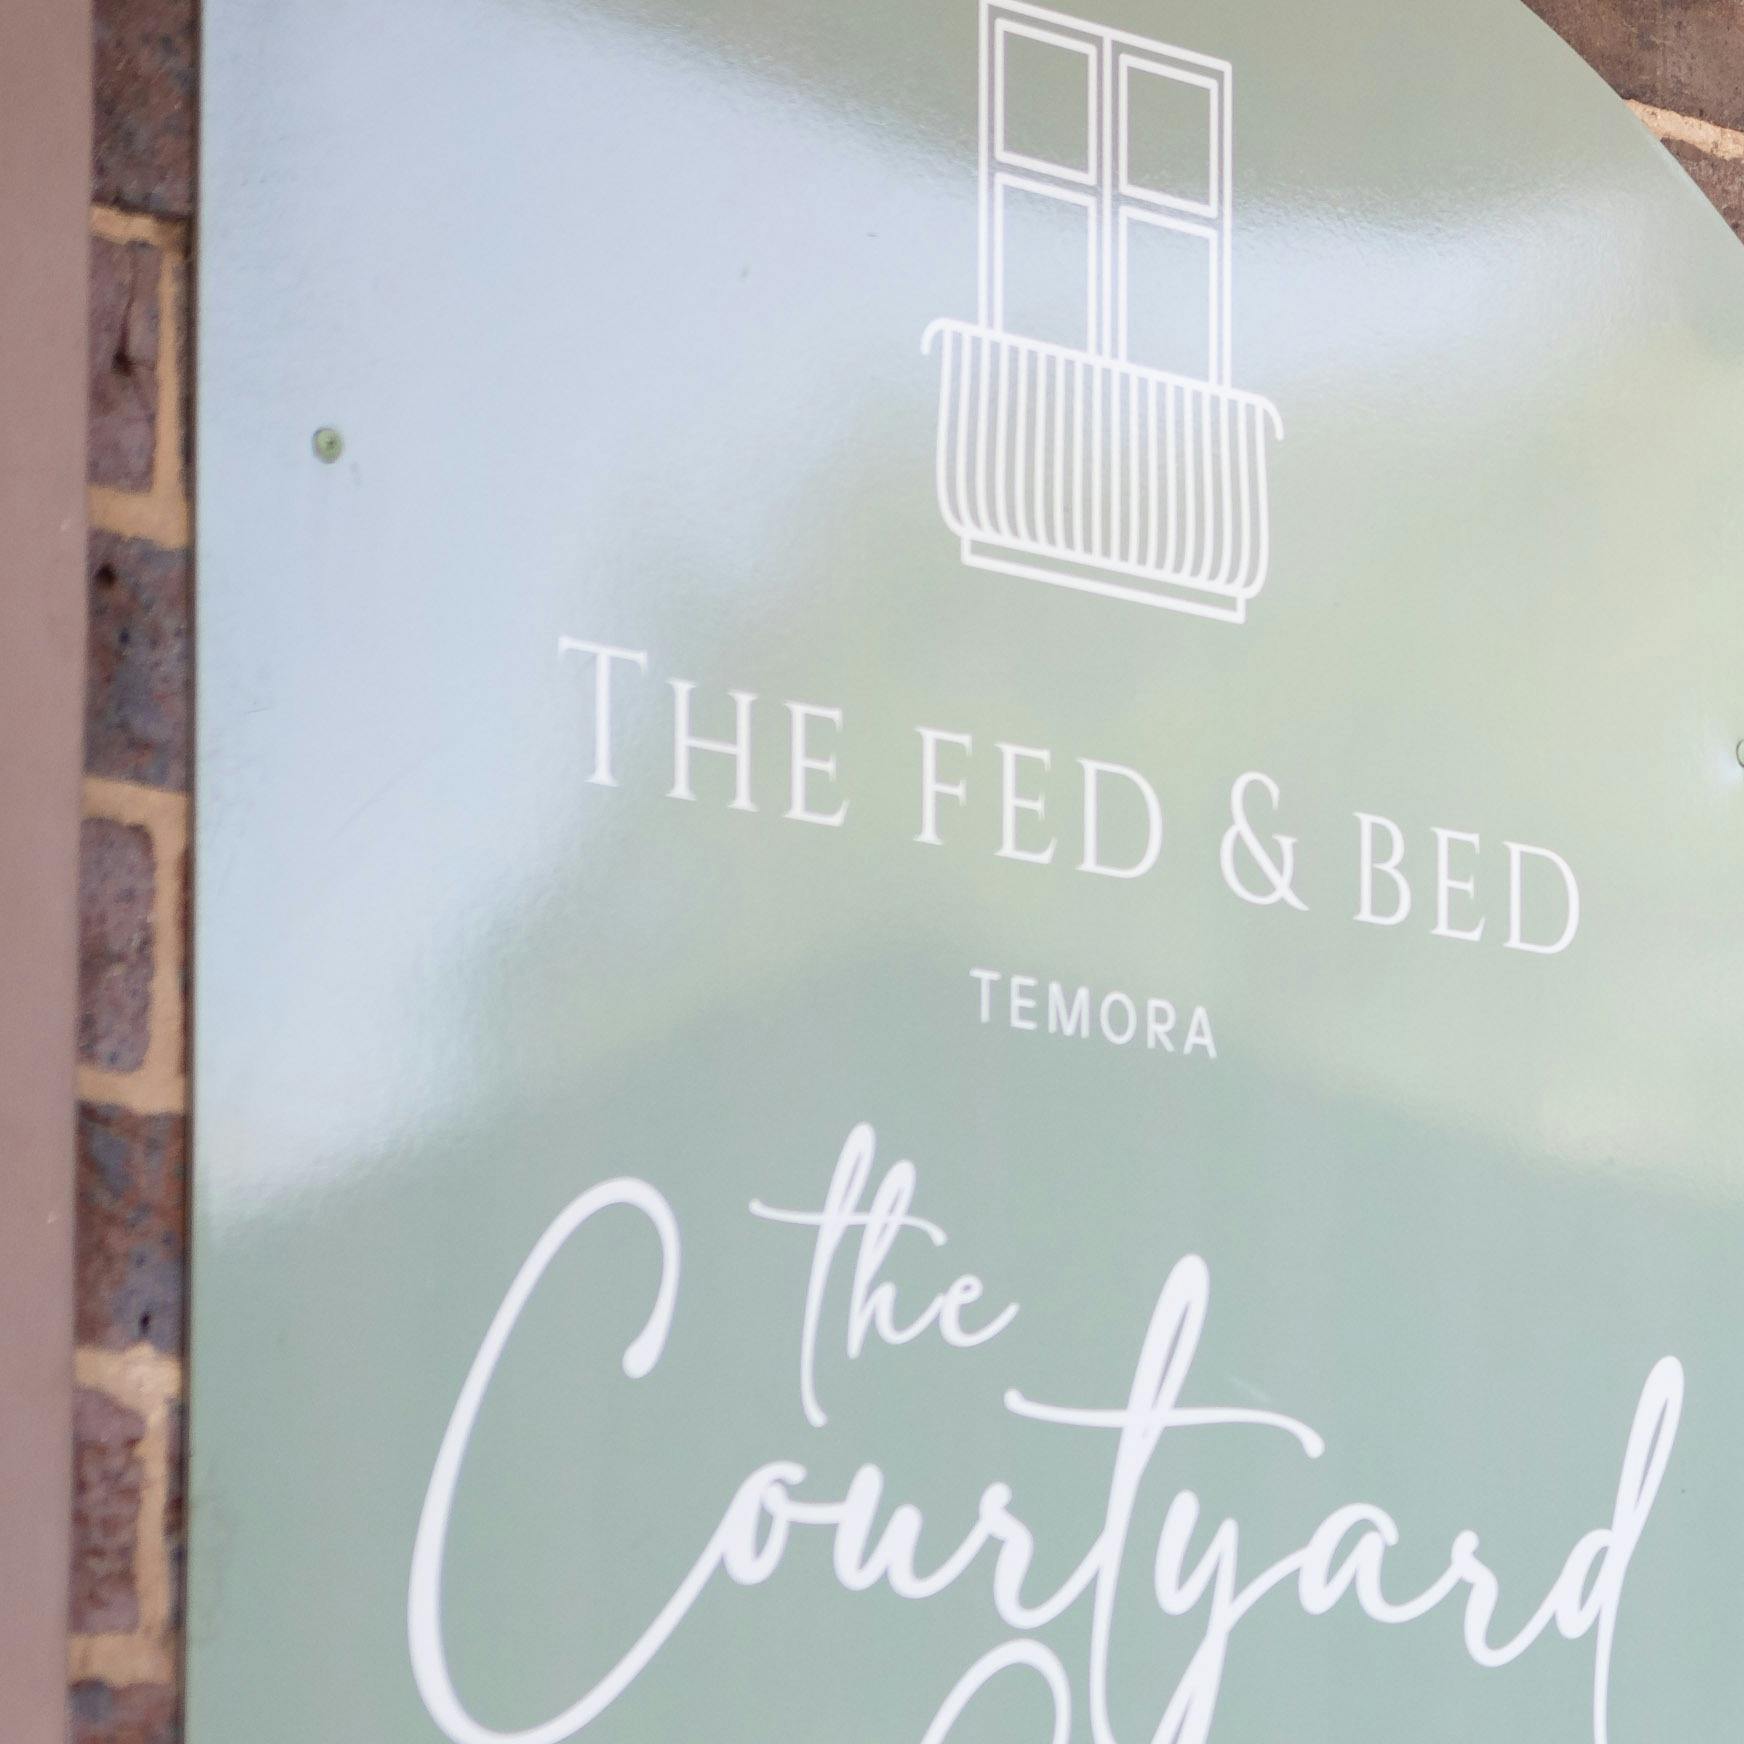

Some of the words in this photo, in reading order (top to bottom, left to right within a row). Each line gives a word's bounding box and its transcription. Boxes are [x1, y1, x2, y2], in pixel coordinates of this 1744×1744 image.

[557, 635, 850, 828] THE
[912, 725, 1163, 879] FED
[1220, 771, 1309, 911] &
[1352, 810, 1580, 955] BED
[970, 967, 1219, 1059] TEMORA
[749, 1121, 1019, 1428] the
